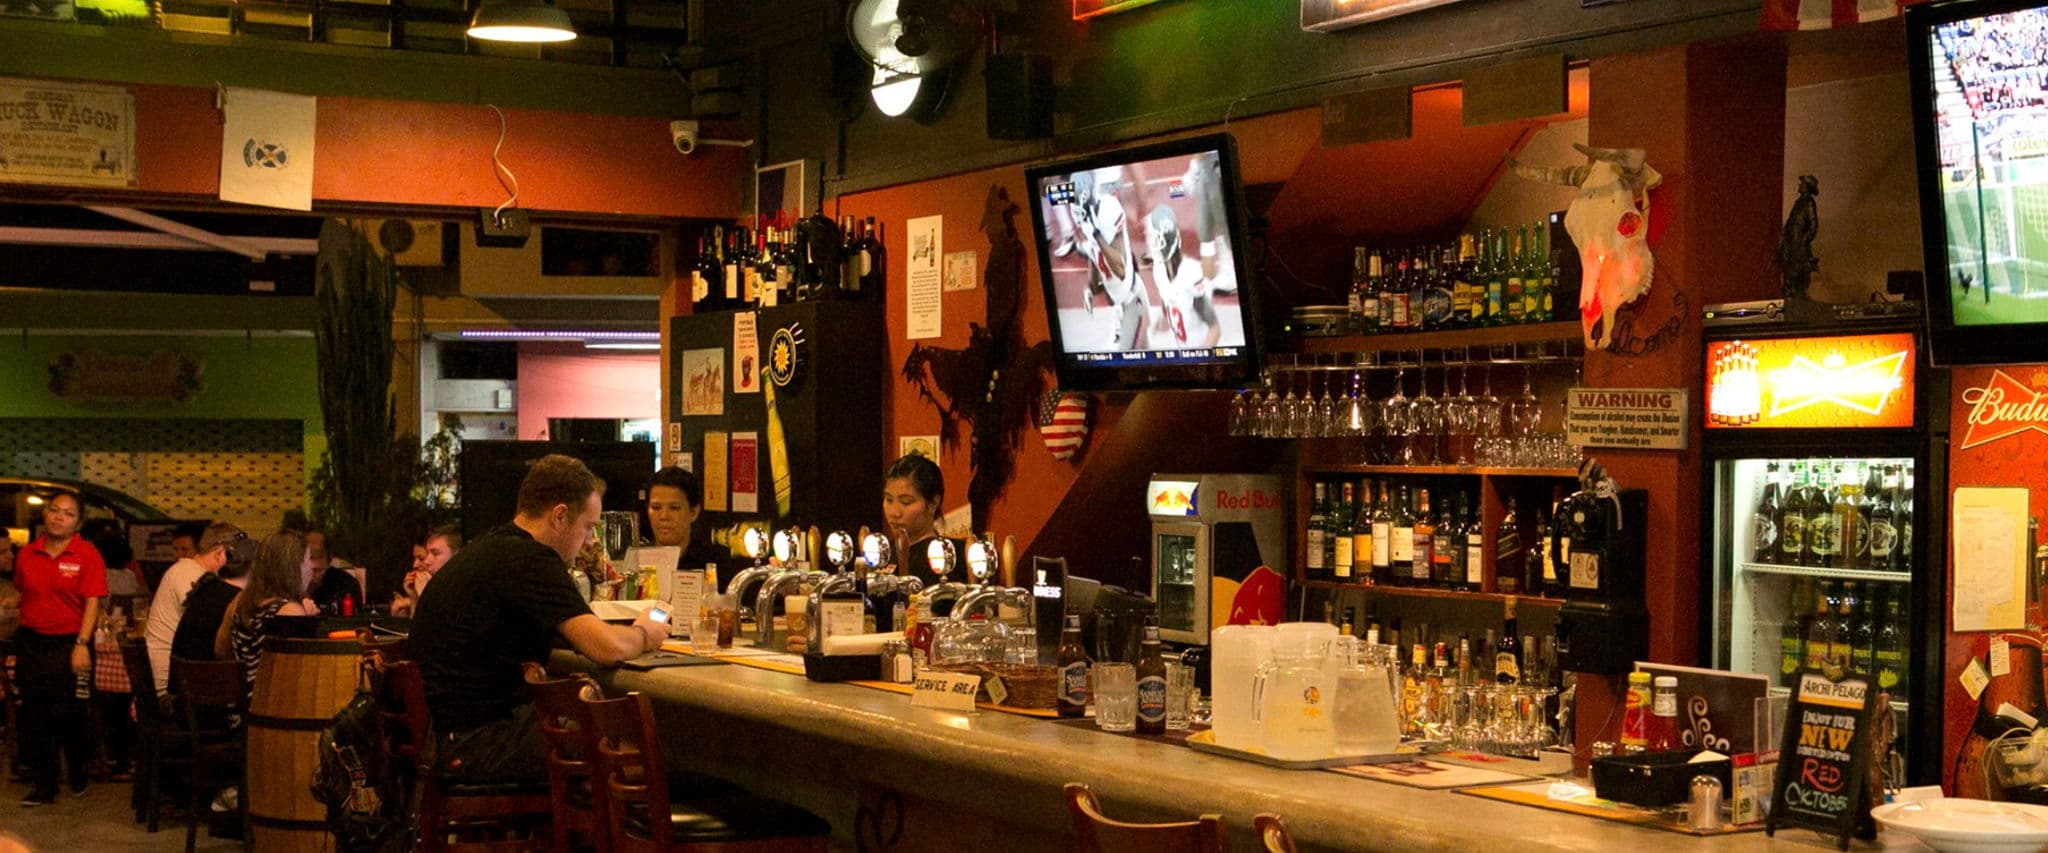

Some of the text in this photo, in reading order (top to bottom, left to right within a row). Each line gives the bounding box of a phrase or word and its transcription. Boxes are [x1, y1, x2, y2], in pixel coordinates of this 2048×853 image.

[0, 101, 118, 132] UCK WAGON
[1578, 393, 1672, 408] WARNING
[1570, 411, 1600, 422] Consumption
[1607, 411, 1625, 421] alcohol
[1626, 413, 1635, 423] may
[1637, 413, 1652, 422] create
[1580, 425, 1589, 435] you
[1590, 425, 1598, 433] are
[1650, 426, 1660, 435] and
[1604, 437, 1615, 445] you
[1616, 436, 1639, 446] actually
[1641, 437, 1651, 445] are
[1216, 489, 1249, 509] Red
[915, 679, 976, 695] SERVICE AREA
[1803, 710, 1832, 726] ENJOY
[1799, 725, 1855, 751] NEW
[1802, 758, 1844, 792] RED
